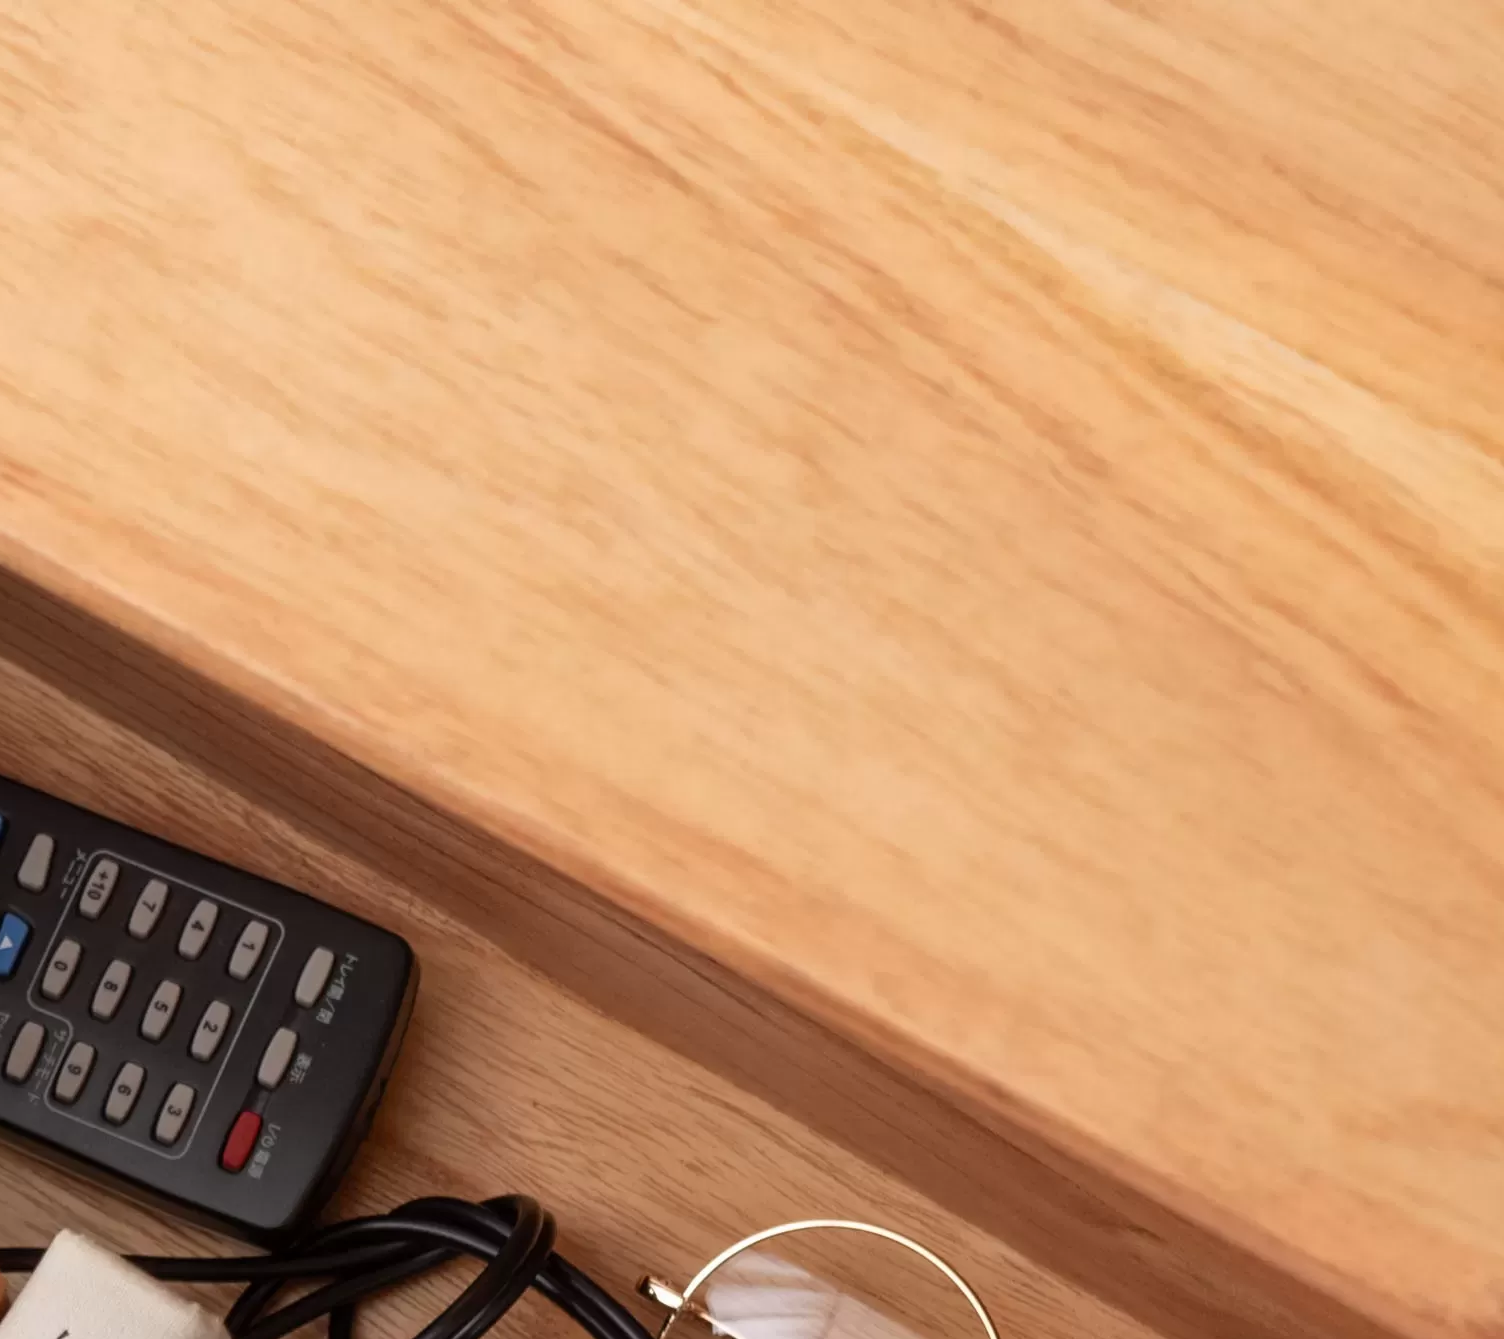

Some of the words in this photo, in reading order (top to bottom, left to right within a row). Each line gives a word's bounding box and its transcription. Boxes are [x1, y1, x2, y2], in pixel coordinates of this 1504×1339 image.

[87, 871, 108, 900] +10
[142, 901, 157, 913] 7
[191, 920, 204, 932] 4
[241, 942, 256, 953] 1
[54, 960, 68, 972] 0
[104, 981, 118, 992] 8
[154, 1001, 169, 1013] 5
[203, 1020, 218, 1033] 2
[67, 1064, 82, 1076] 9
[117, 1084, 132, 1096] 6
[167, 1105, 182, 1117] 3
